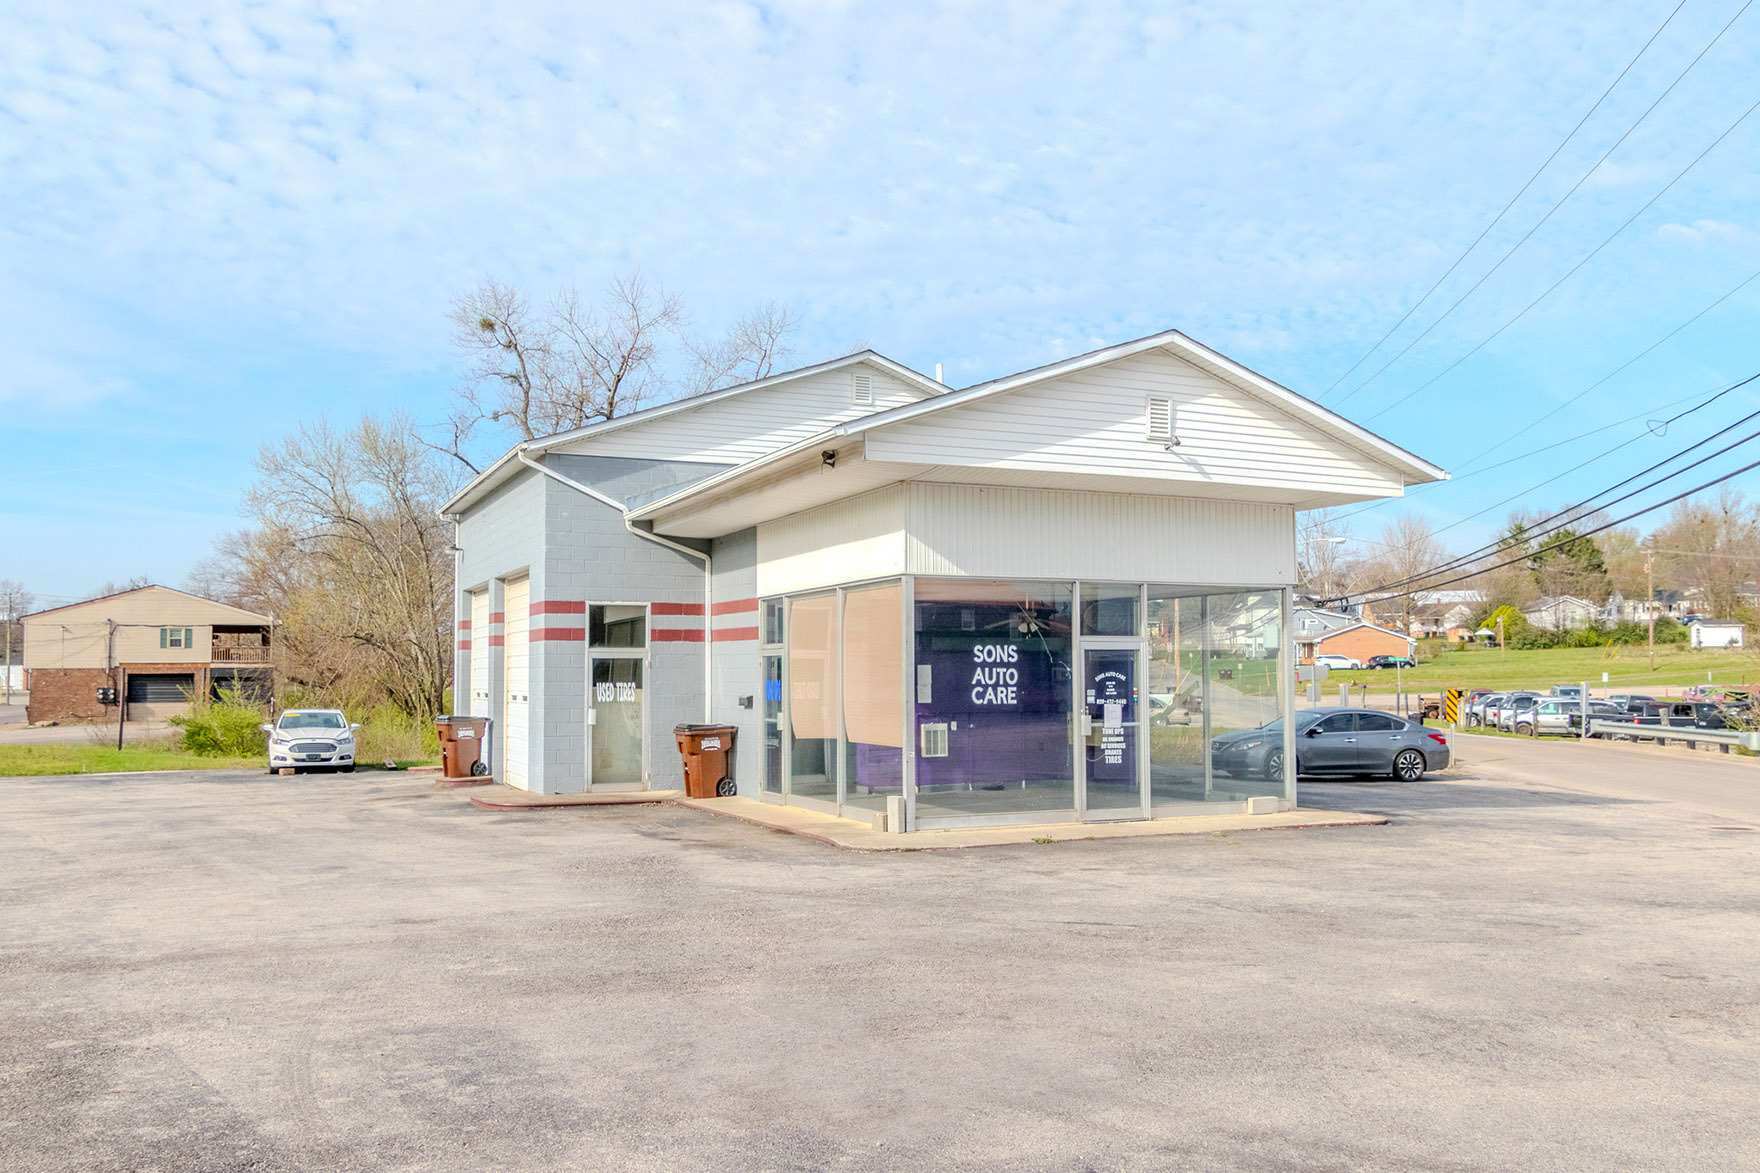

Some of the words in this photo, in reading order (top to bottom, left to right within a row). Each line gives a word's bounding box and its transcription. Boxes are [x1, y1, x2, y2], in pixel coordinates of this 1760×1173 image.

[973, 644, 1018, 663] SONS
[971, 667, 1018, 685] AUTO
[596, 682, 615, 702] USED
[616, 682, 636, 702] TIRES
[971, 686, 1018, 704] CARE
